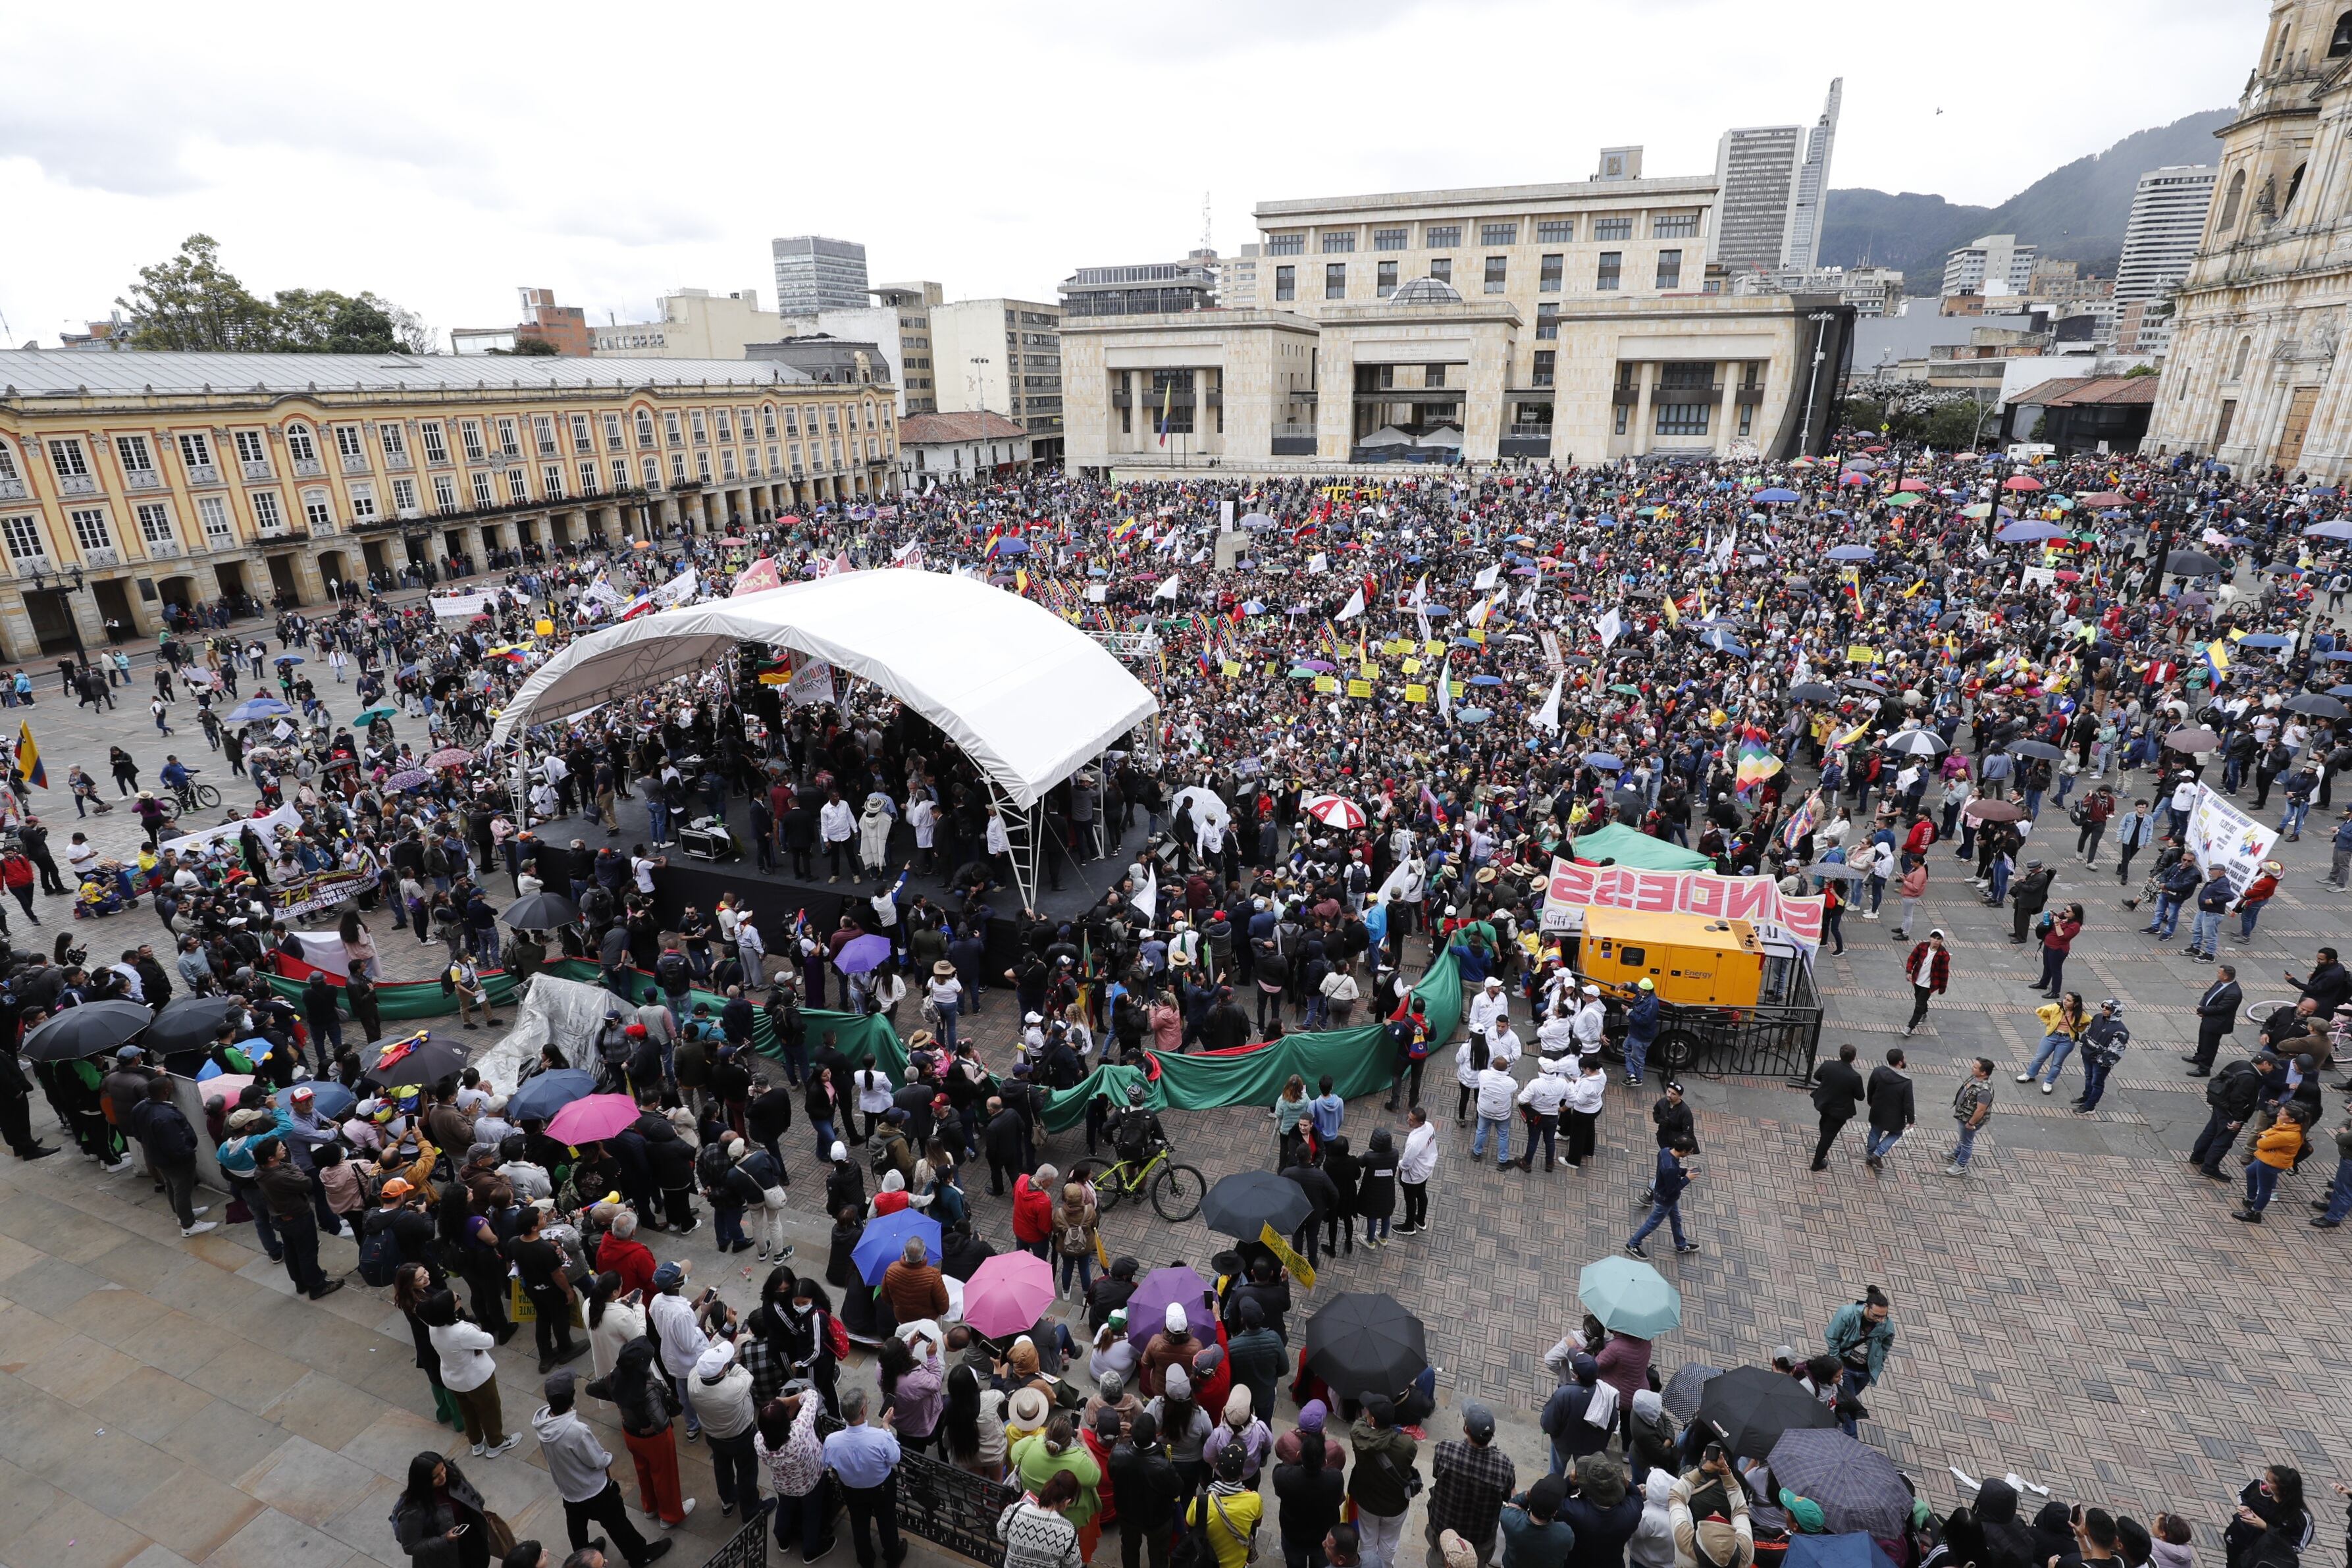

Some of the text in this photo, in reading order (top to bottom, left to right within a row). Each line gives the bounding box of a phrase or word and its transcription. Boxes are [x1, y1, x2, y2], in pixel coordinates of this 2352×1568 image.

[1037, 541, 1051, 563] CUT
[1040, 581, 1052, 603] CUT
[1051, 580, 1063, 603] CUT
[1066, 581, 1082, 603] CUT
[1196, 615, 1208, 639] CUT
[1322, 623, 1335, 648] CUT
[1221, 632, 1232, 657] CUT
[2233, 860, 2251, 874] LIBERTAD
[318, 879, 358, 893] SERVIDORES
[344, 881, 369, 894] CAMBIO
[278, 900, 322, 918] FEBRERO
[328, 897, 338, 905] LA
[339, 893, 352, 902] PAZ
[1685, 969, 1713, 979] Energy
